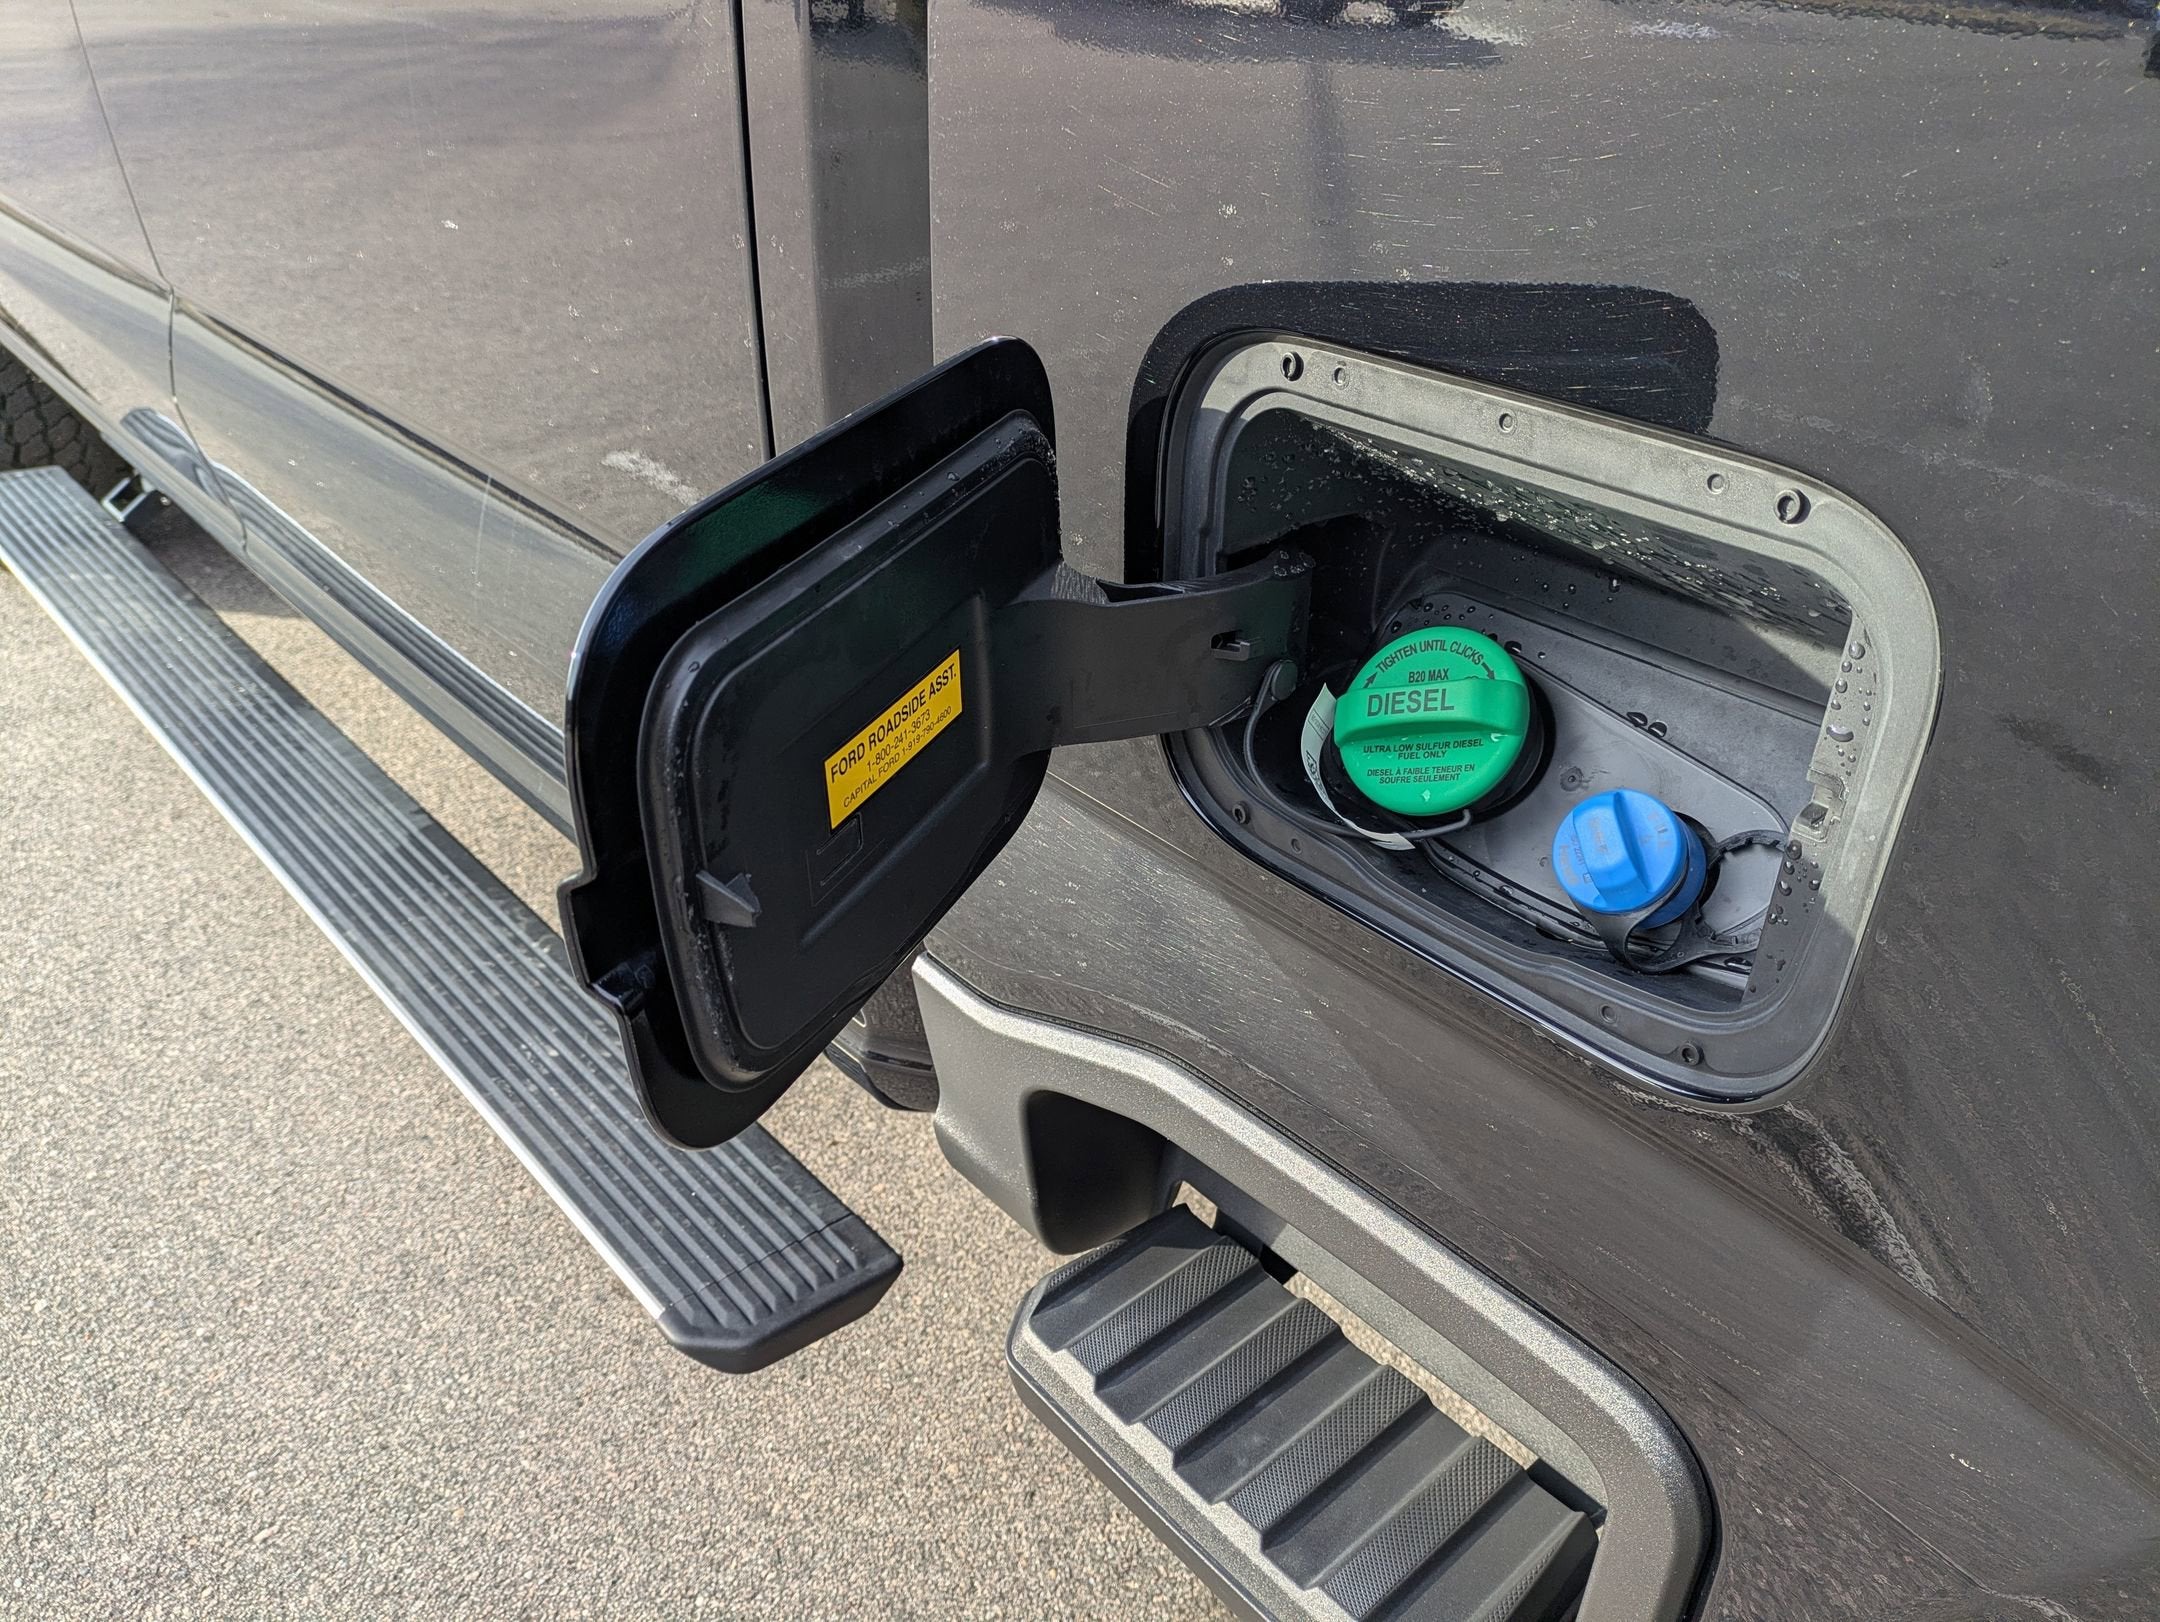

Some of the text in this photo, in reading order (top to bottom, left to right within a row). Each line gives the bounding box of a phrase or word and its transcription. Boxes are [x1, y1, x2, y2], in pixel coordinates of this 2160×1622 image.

[1376, 639, 1485, 673] TIGHTEN UNTIL CLICKS
[1408, 668, 1449, 683] B20 MAX
[1367, 688, 1455, 717] DIESEL
[831, 663, 957, 784] FORD ROADSIDE ASST.
[866, 708, 931, 772] 1-800-241-3673
[1363, 738, 1484, 754] ULTRA LOW SULFUR DIESEL
[1397, 751, 1447, 760] FUEL ONLY
[843, 776, 877, 808] CAPITAL
[878, 752, 900, 778] FORD
[1367, 768, 1393, 777] DIESEL
[1403, 766, 1430, 775] FAIBLE
[1432, 764, 1463, 774] TENEUR
[1464, 764, 1475, 772] EN
[1379, 773, 1461, 784] SOUFRE SEULEMENT
